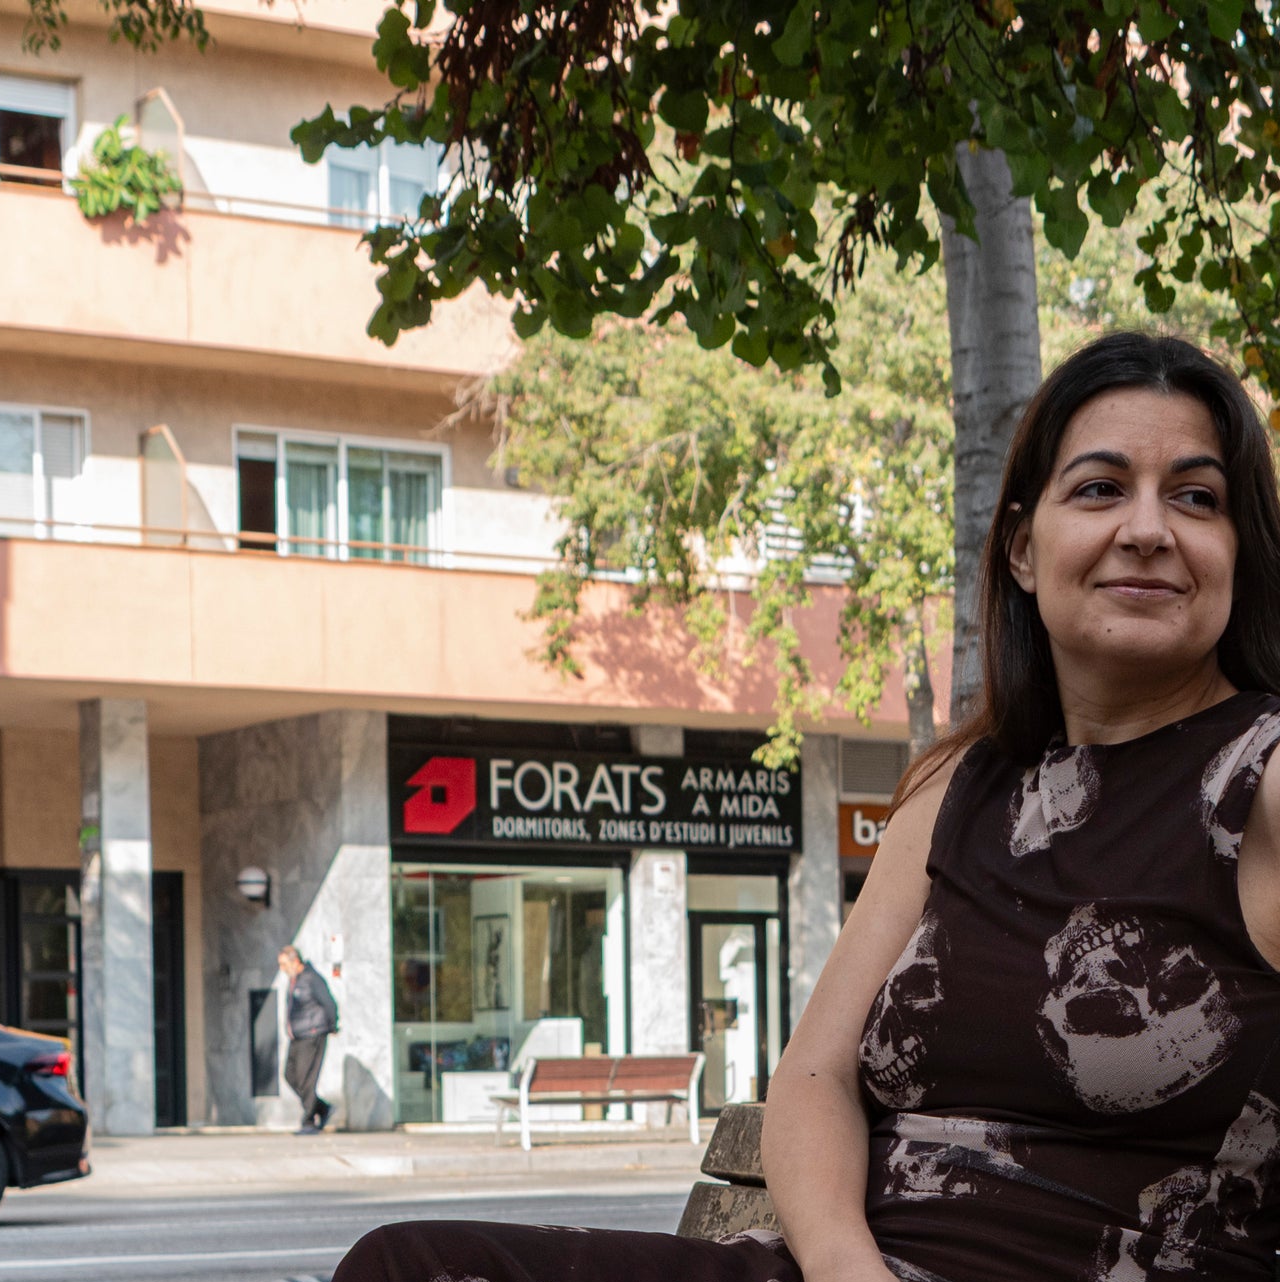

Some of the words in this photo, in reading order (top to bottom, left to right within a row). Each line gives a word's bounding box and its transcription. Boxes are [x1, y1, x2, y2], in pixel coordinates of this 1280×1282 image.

[489, 758, 667, 815] FORATS
[681, 766, 791, 795] ARMARIS
[692, 793, 711, 816] A
[720, 794, 780, 819] MIDA
[492, 816, 591, 842] DORMITORIS,
[598, 818, 646, 842] ZONES
[649, 819, 716, 843] D'ESTUDI
[720, 823, 726, 843] I
[728, 823, 793, 848] JUVENILS
